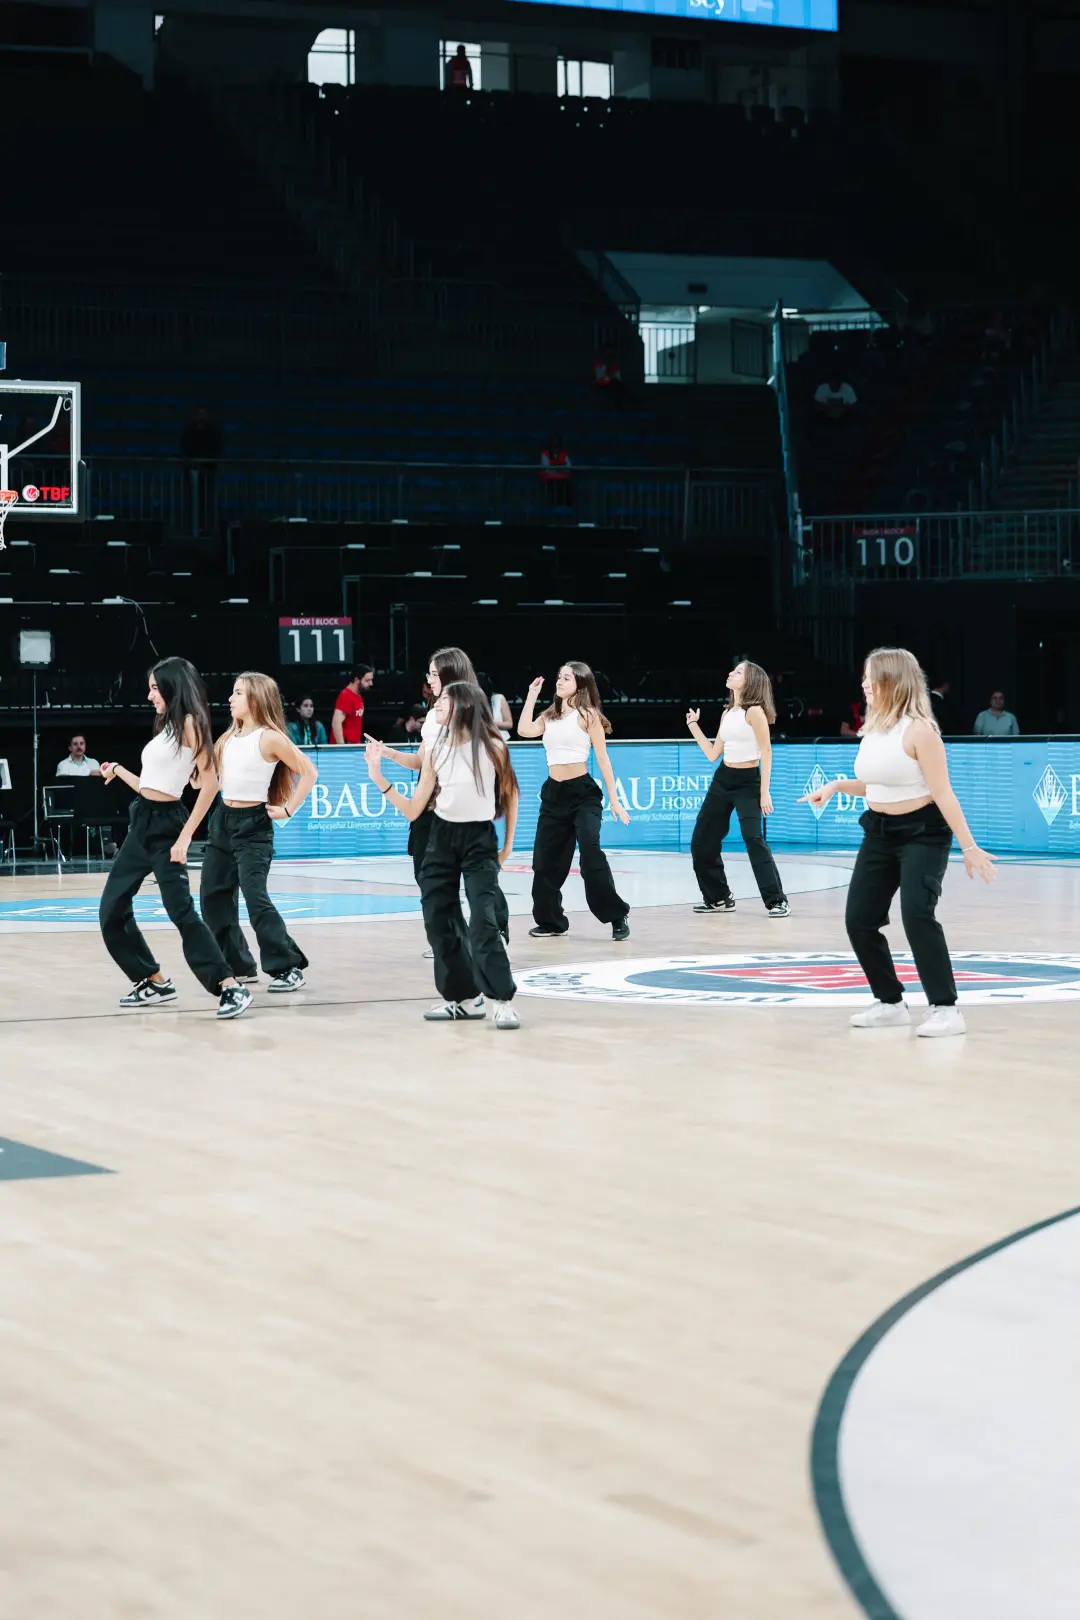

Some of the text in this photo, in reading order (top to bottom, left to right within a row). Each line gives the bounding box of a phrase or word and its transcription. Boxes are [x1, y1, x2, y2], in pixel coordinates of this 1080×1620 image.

[39, 485, 70, 501] TBF
[856, 537, 914, 566] 110
[291, 618, 339, 626] BLOK BLOCK
[288, 629, 345, 662] 111
[308, 783, 387, 819] BAU
[662, 796, 706, 810] HOSP
